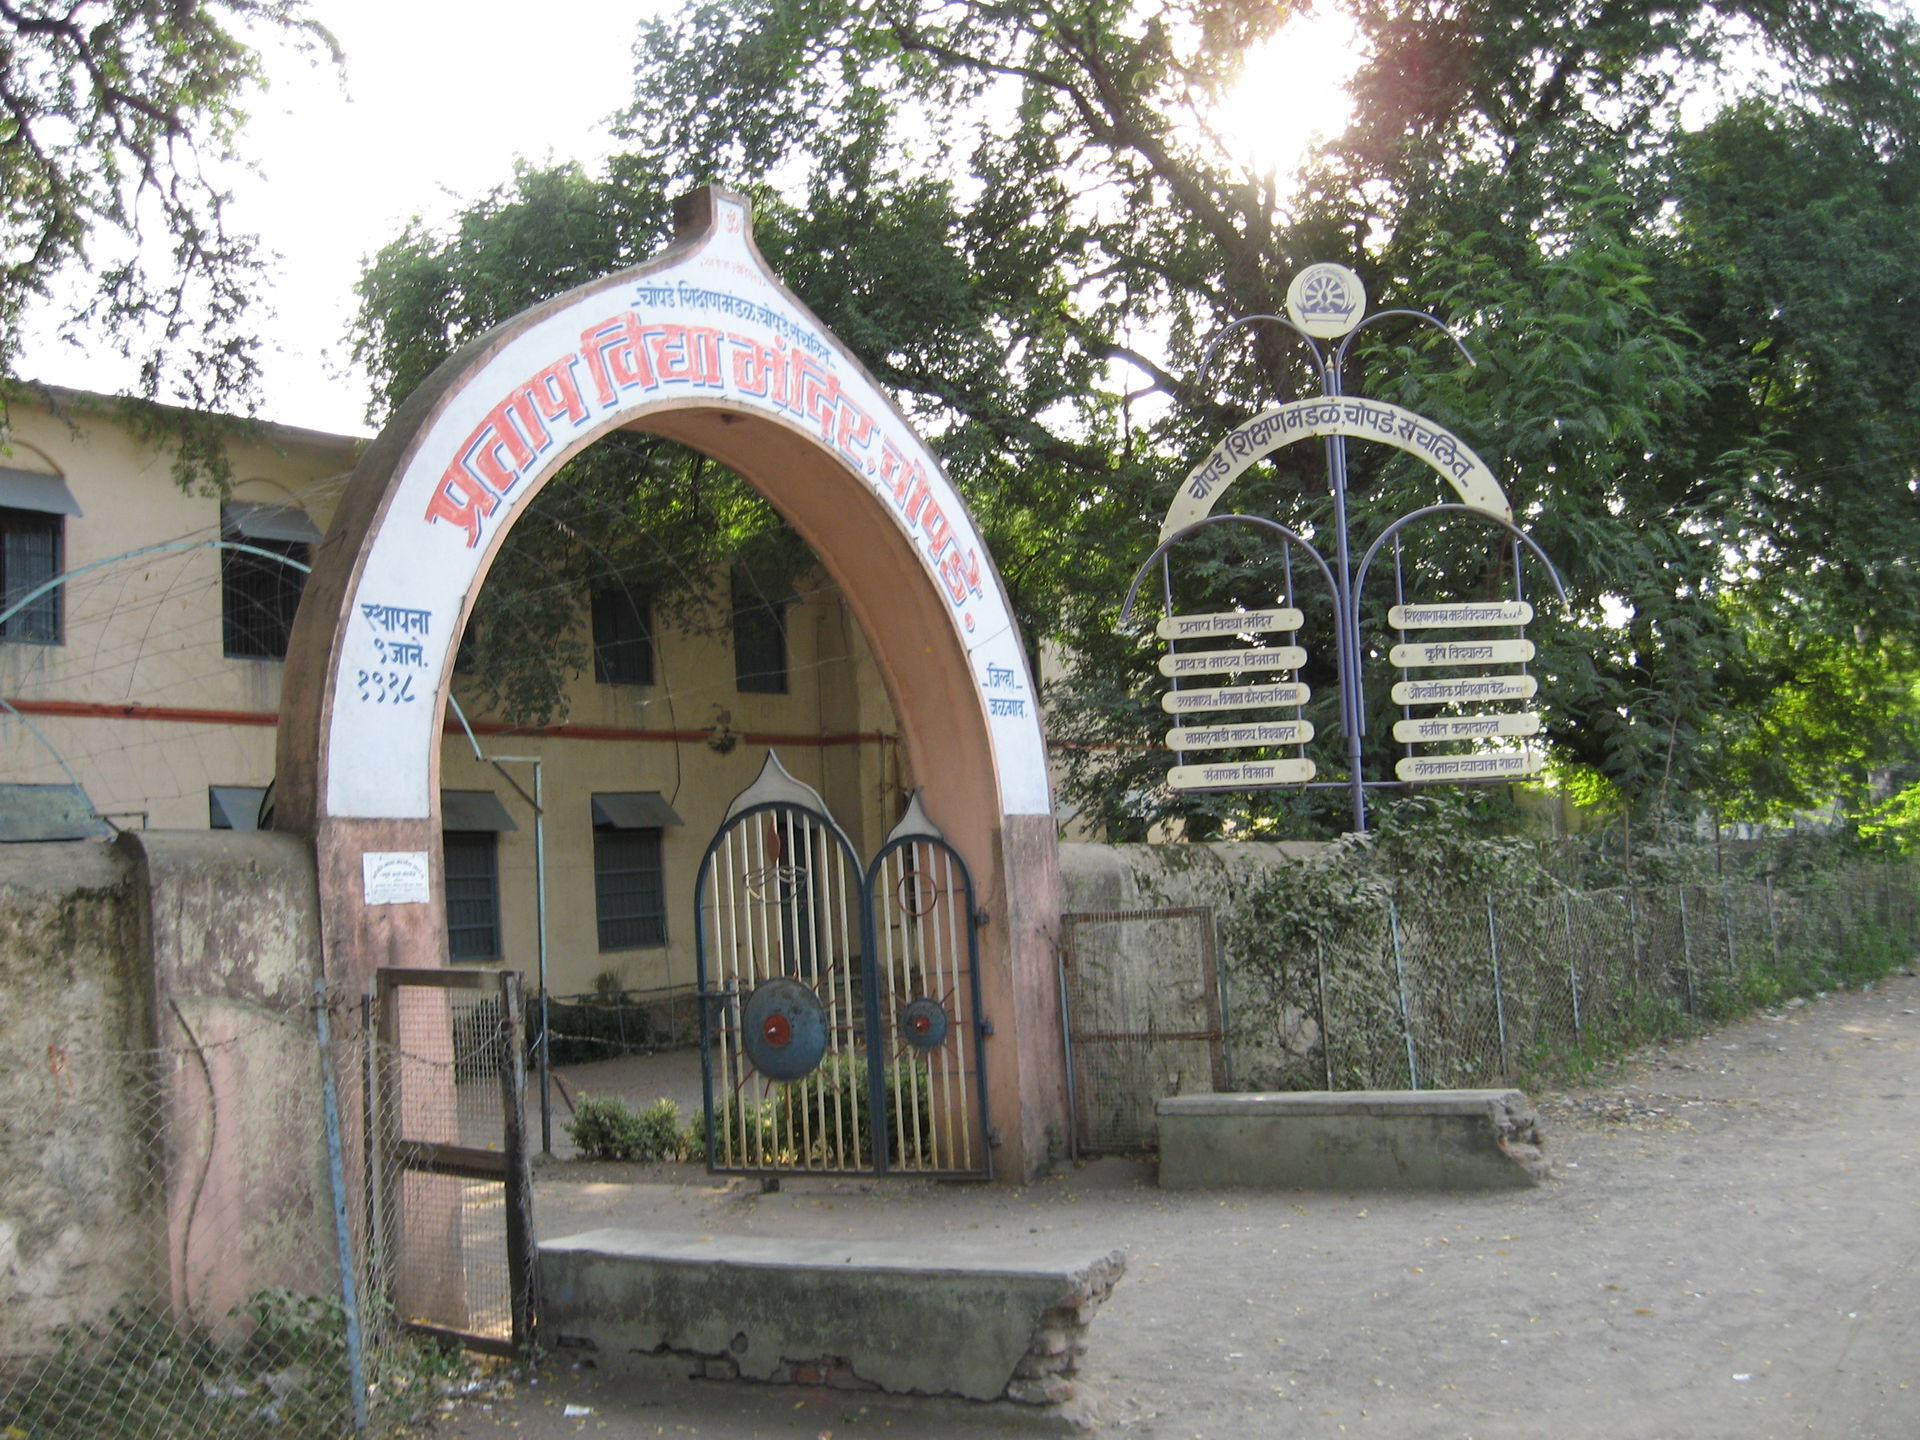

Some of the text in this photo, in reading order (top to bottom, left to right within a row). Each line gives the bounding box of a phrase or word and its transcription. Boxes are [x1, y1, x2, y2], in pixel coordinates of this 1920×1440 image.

[424, 352, 590, 548] प्रताप
[580, 311, 723, 408] विद्या
[1188, 452, 1231, 502] चोपडे
[361, 603, 432, 635] स्थापना
[1178, 611, 1275, 635] प्रताप विद्या मंदिर
[1243, 652, 1281, 667] विभाग
[1425, 644, 1494, 664] कृषि विद्यालय
[1418, 720, 1449, 738] संगीत
[1203, 763, 1275, 782] संगणक विभाग
[1414, 759, 1459, 776] लोकमान्य
[1499, 757, 1524, 771] शाळा
